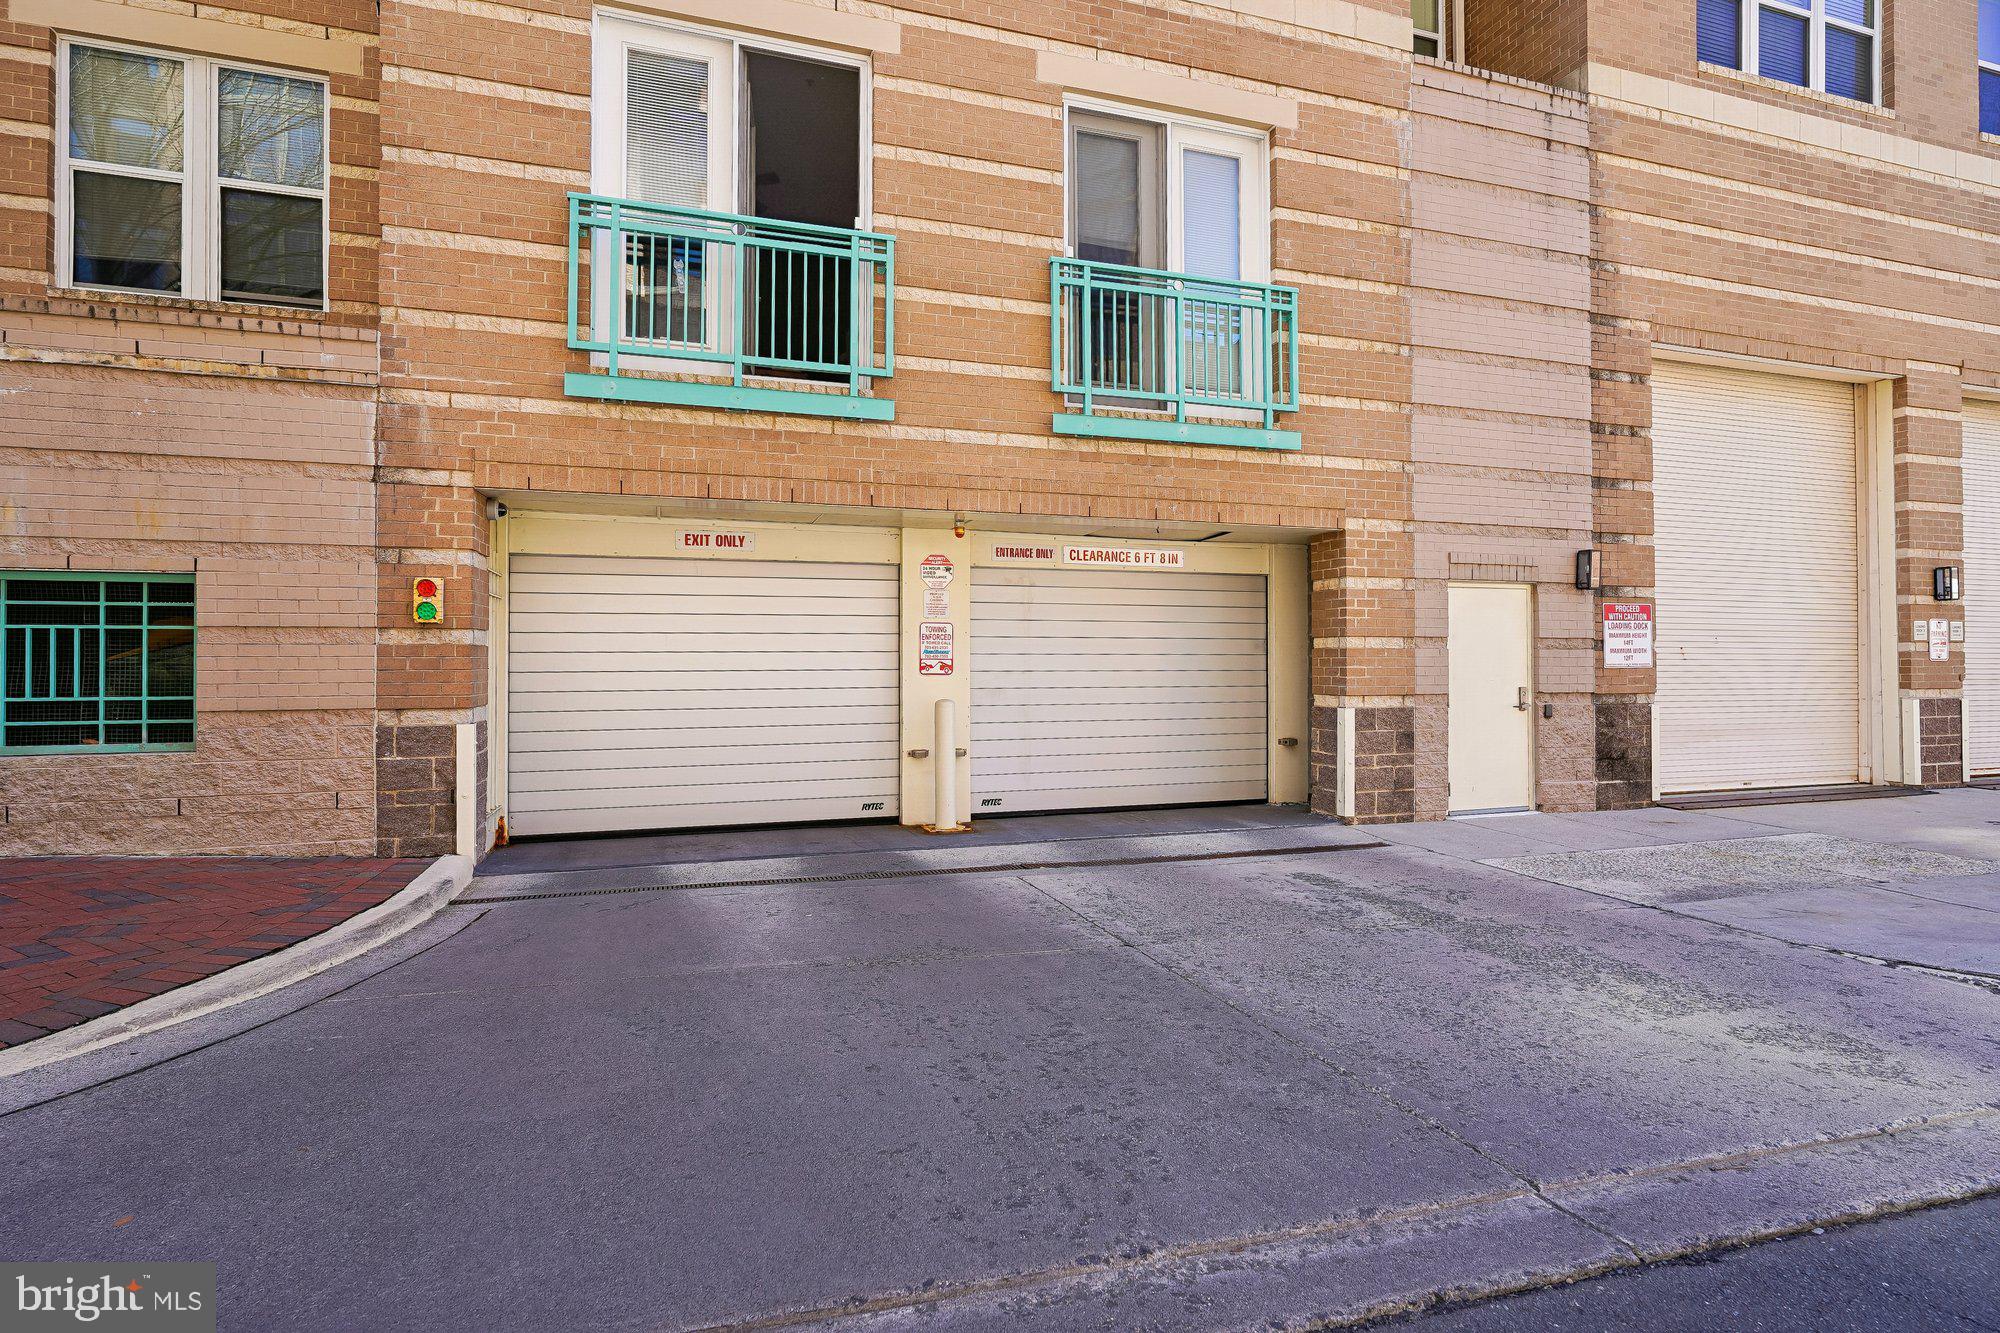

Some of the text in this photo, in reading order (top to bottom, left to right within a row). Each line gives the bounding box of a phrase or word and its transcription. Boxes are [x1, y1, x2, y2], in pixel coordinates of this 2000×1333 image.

[684, 533, 746, 548] EXIT ONLY
[995, 546, 1054, 559] ENTRANCE ONLY
[1069, 549, 1179, 565] CLEARANCE 6 FT 8 IN
[1615, 605, 1640, 613] PROCEED
[1624, 613, 1648, 621] CAUTION
[1608, 622, 1649, 630] LOADING DOCK
[862, 802, 885, 811] RYTEC
[981, 798, 1003, 807] RYTEC
